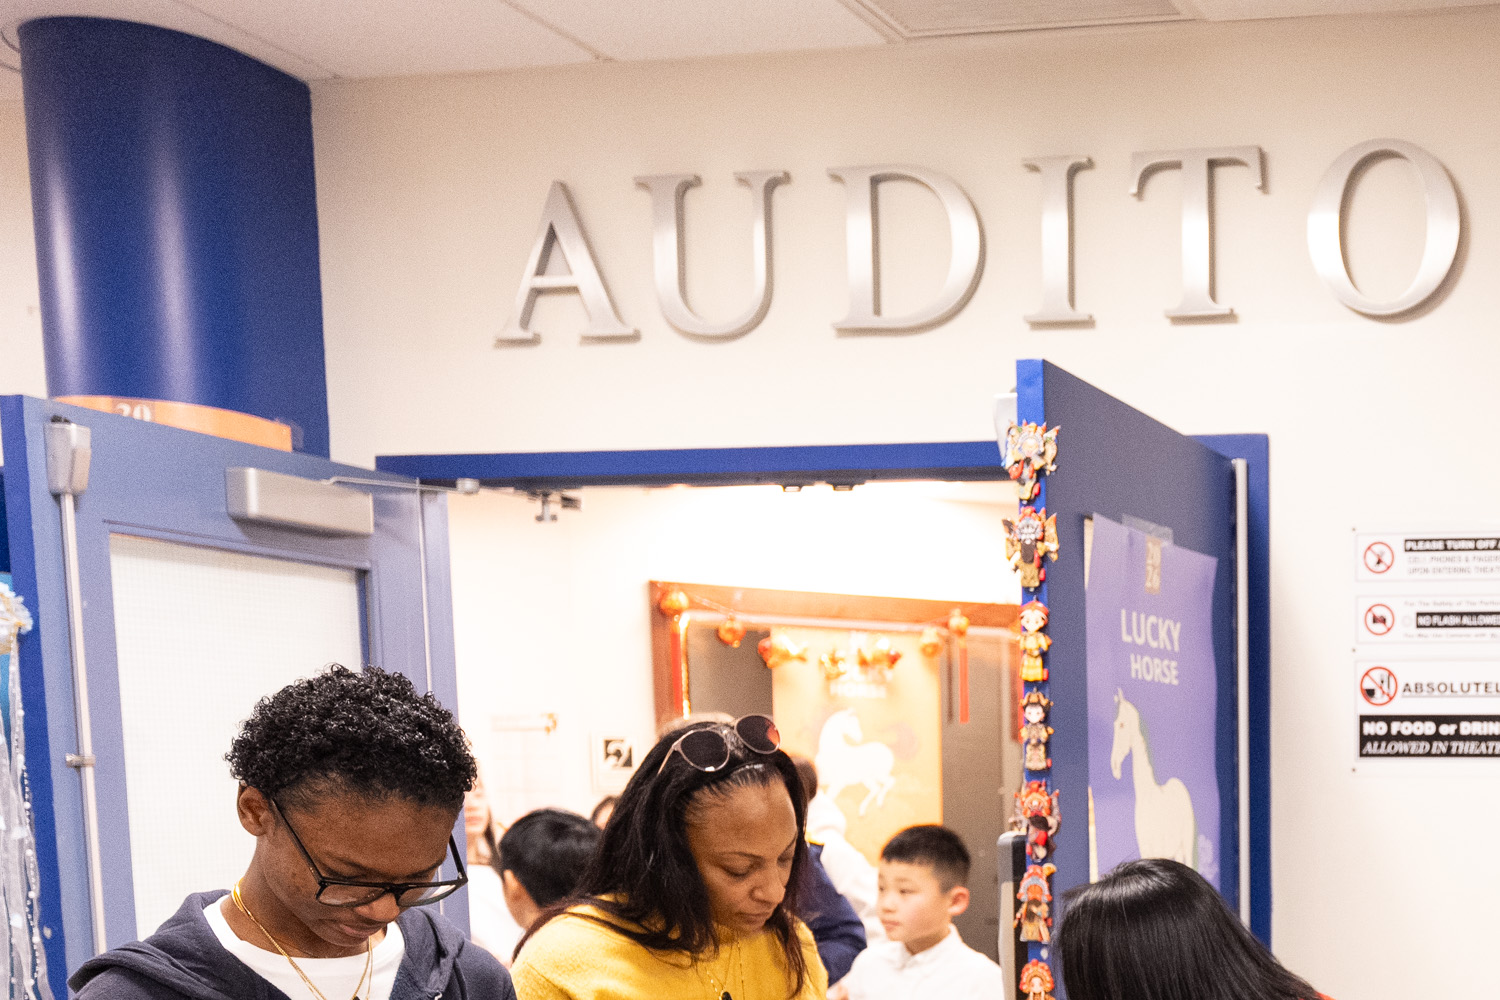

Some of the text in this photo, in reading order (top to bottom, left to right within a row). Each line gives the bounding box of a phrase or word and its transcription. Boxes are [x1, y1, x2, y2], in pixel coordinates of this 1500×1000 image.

[1405, 540, 1445, 551] PLEASE
[1446, 540, 1475, 551] TURN
[1476, 539, 1497, 550] OFF
[1417, 615, 1431, 627] NO
[1432, 615, 1461, 627] FLASH
[1121, 608, 1181, 653] LUCKY
[1130, 653, 1180, 686] HORSE
[1362, 721, 1388, 736] NO
[1390, 721, 1436, 736] FOOD
[1438, 724, 1457, 736] or
[1362, 741, 1431, 754] ALLOWED
[1431, 741, 1449, 754] IN
